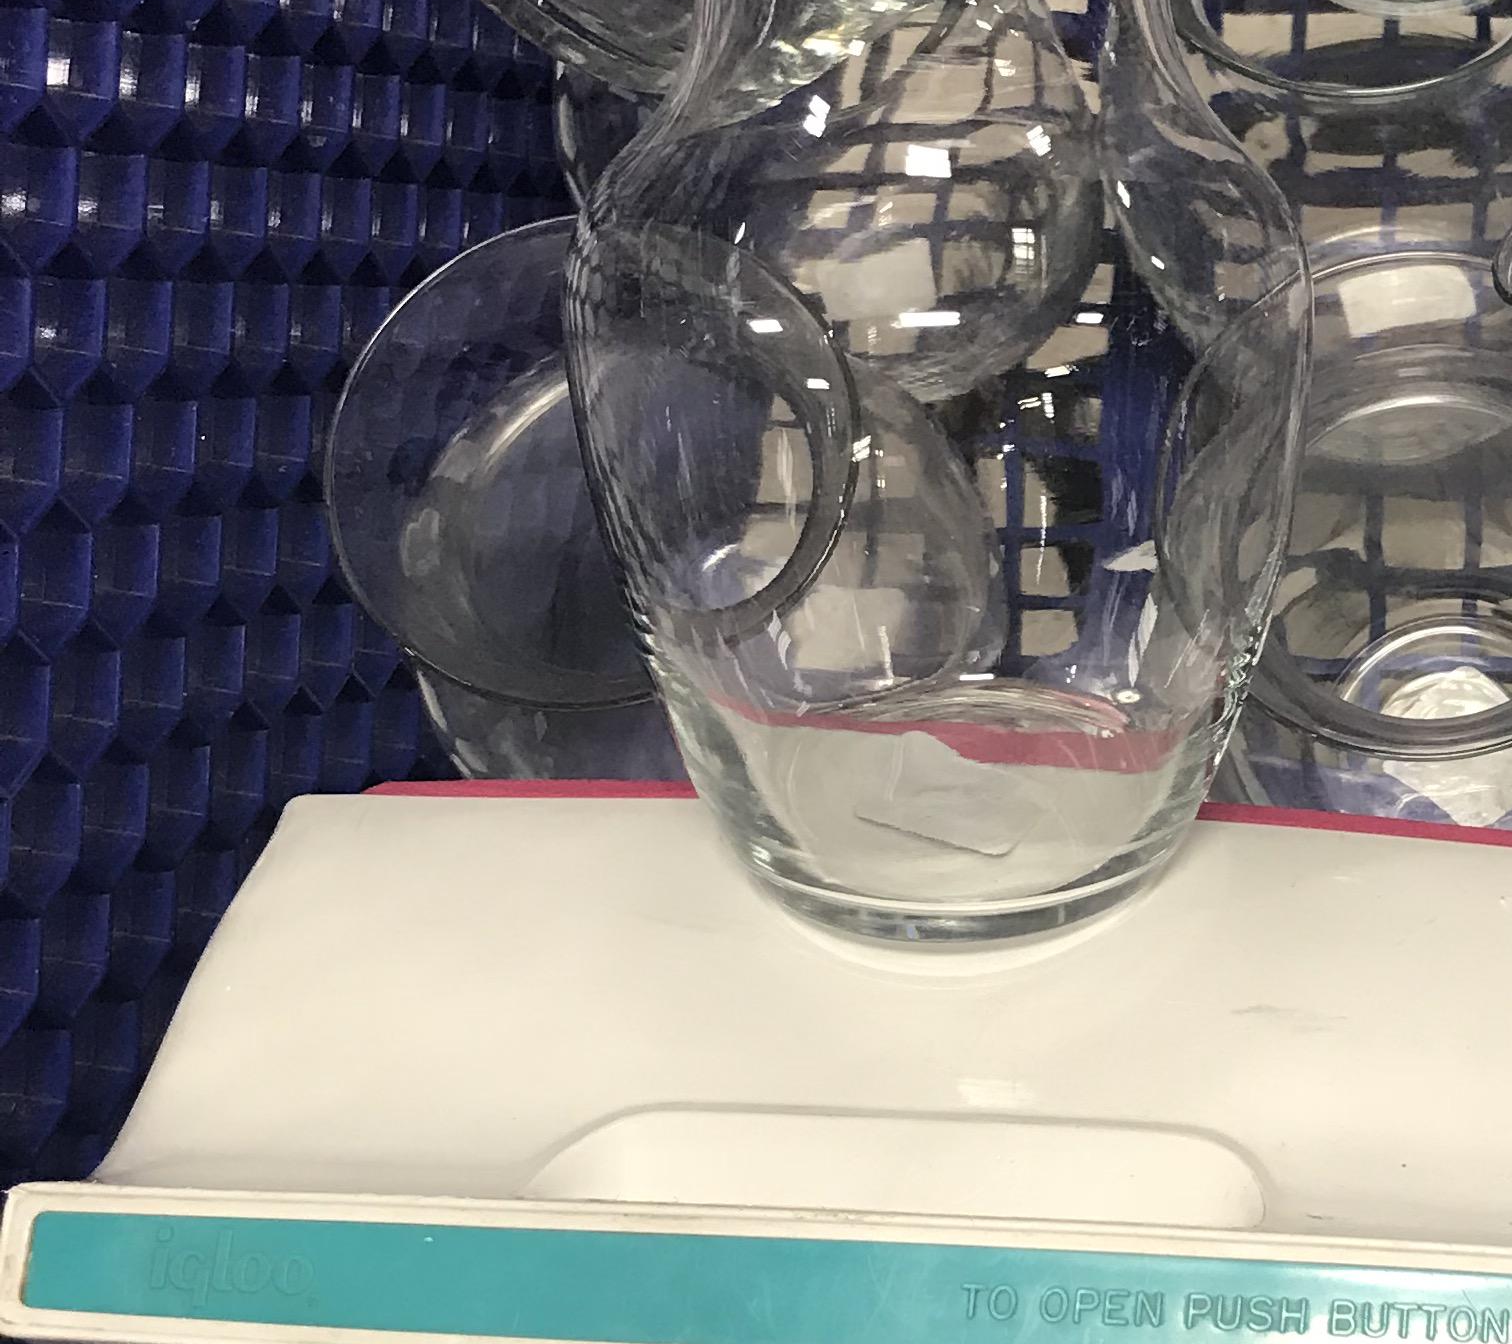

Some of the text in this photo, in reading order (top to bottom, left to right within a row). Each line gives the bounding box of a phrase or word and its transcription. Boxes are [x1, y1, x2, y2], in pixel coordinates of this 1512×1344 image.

[960, 1282, 1511, 1344] TO OPEN PUSH BUTTON
